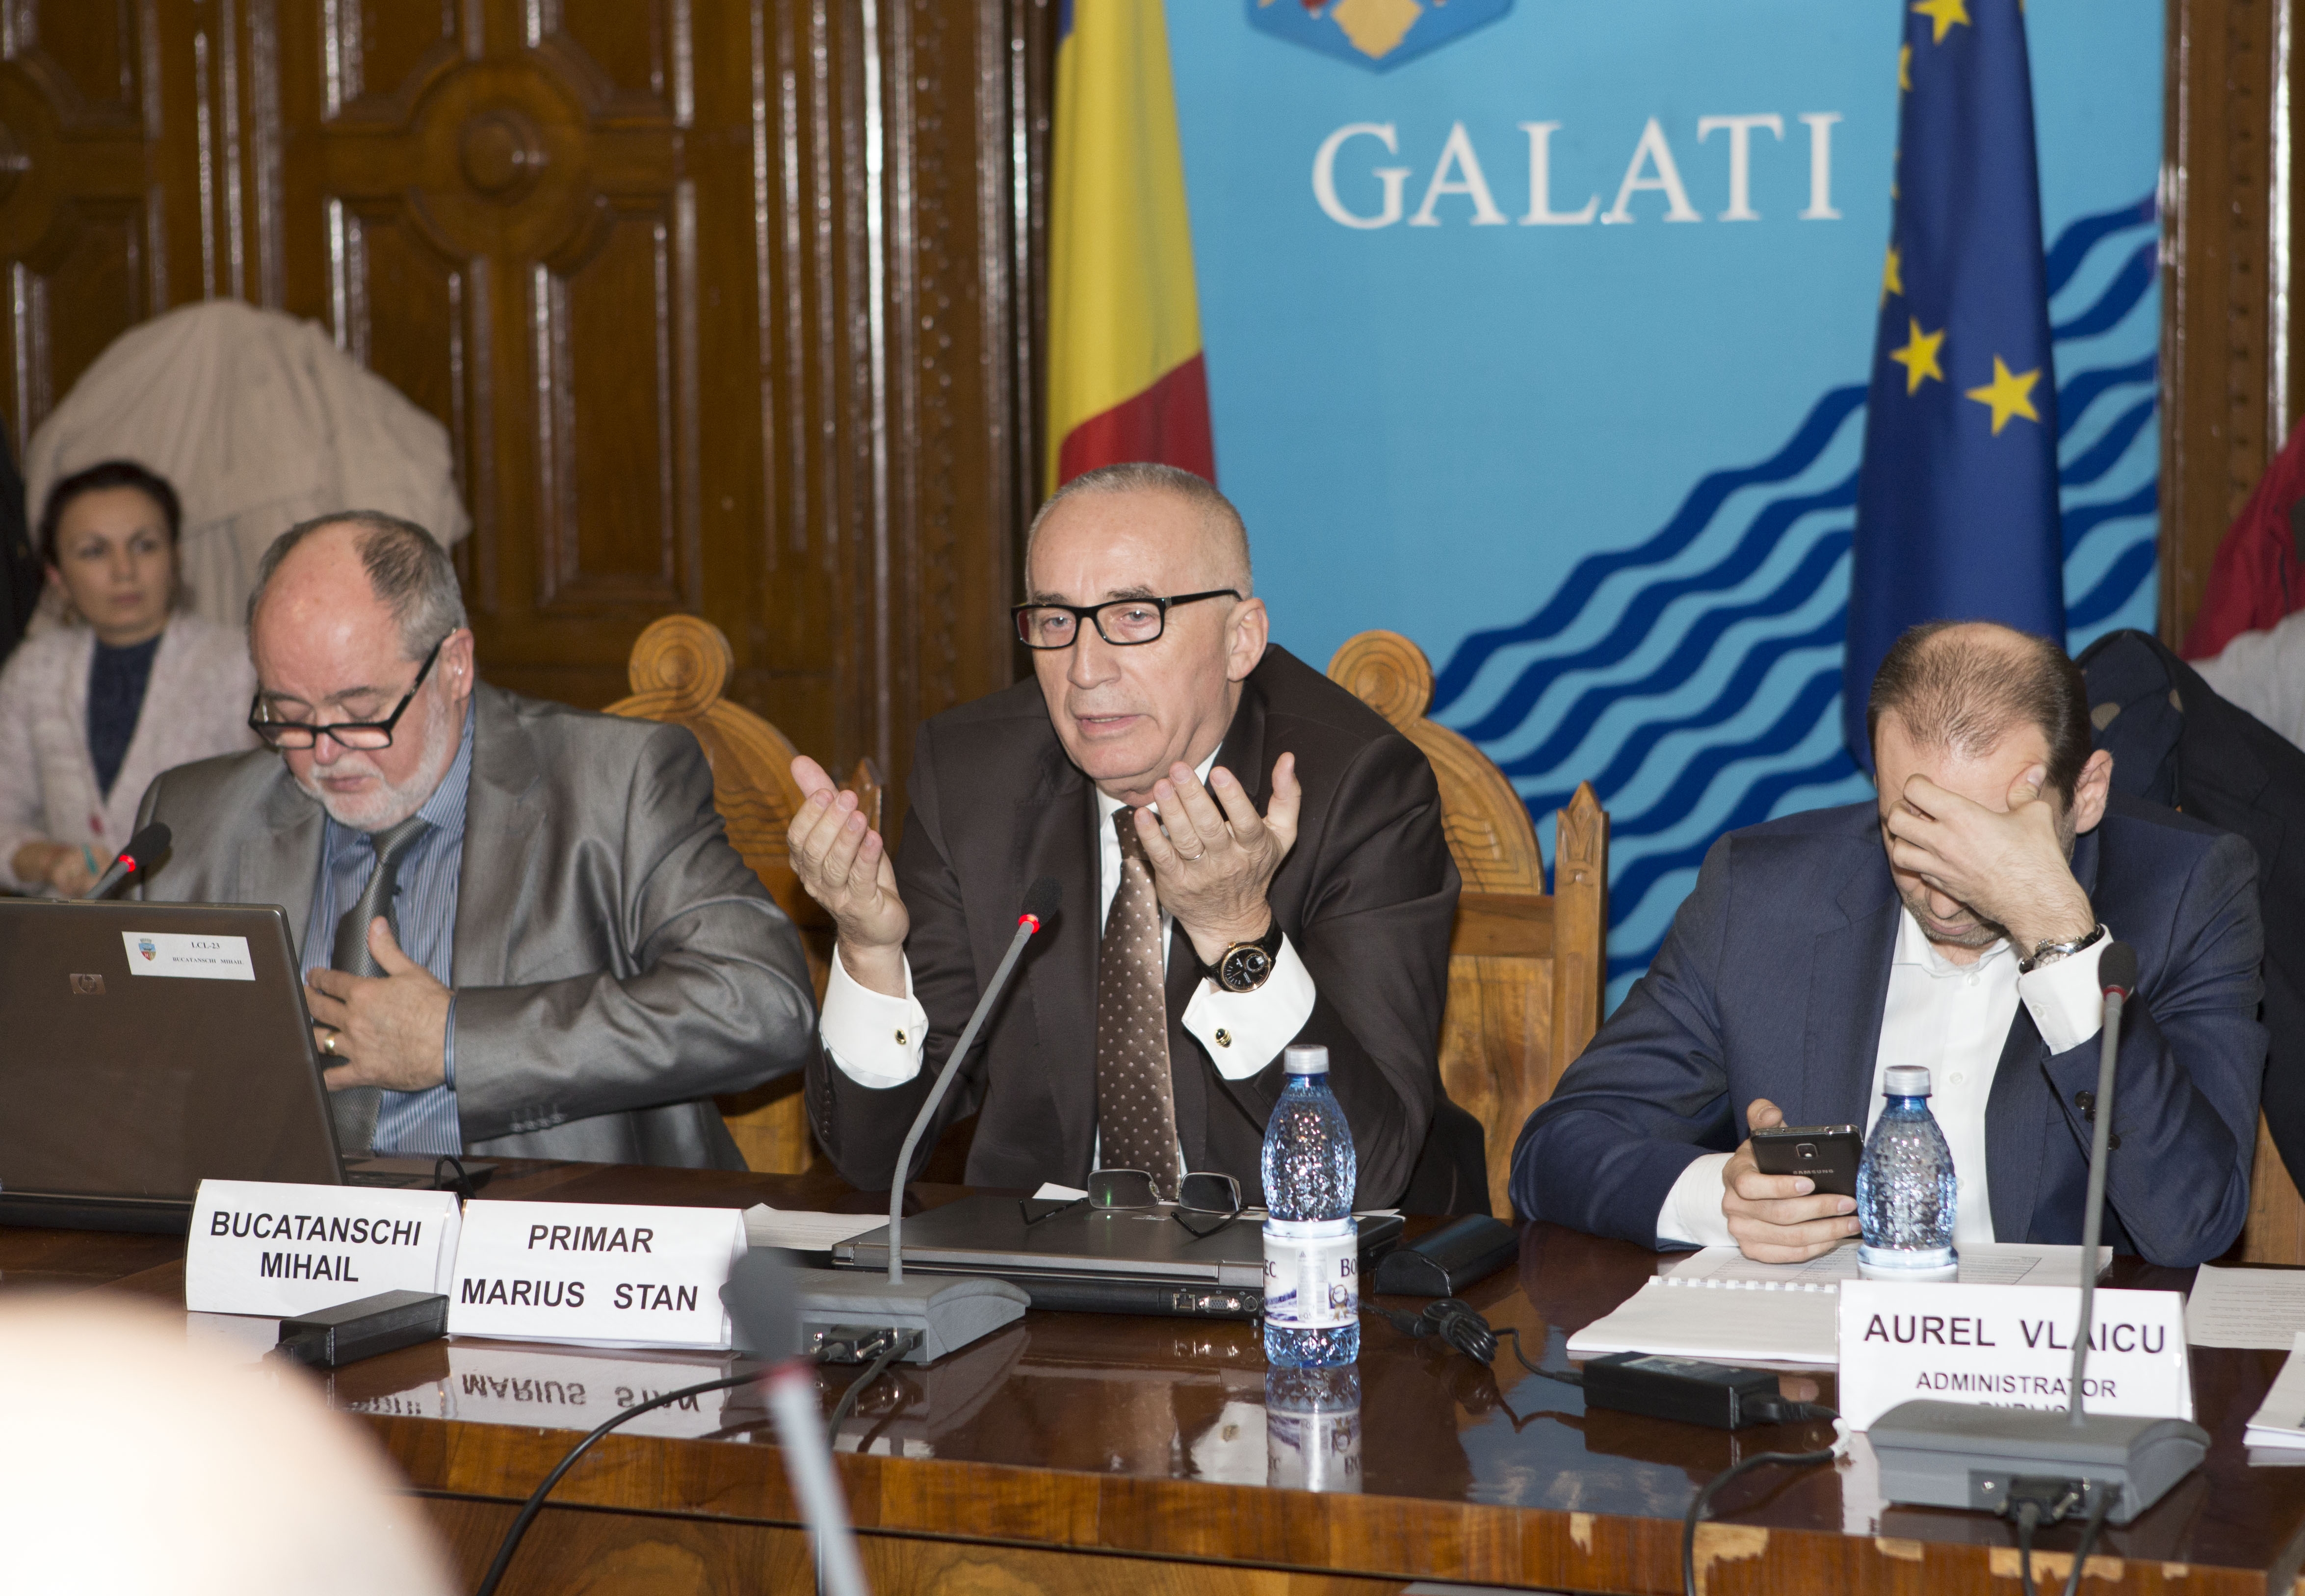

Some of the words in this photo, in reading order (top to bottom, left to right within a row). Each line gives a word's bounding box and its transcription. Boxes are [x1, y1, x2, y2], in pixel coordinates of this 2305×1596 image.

[1312, 113, 1843, 229] GALATI
[210, 1211, 421, 1246] BUCATANSCHI
[528, 1225, 654, 1253] PRIMAR
[261, 1252, 359, 1282] MIHAIL
[461, 1278, 585, 1308] MARIUS
[614, 1283, 698, 1311] STAN
[1864, 1314, 1995, 1347] AUREL
[1916, 1372, 2117, 1398] ADMINISTRAOR
